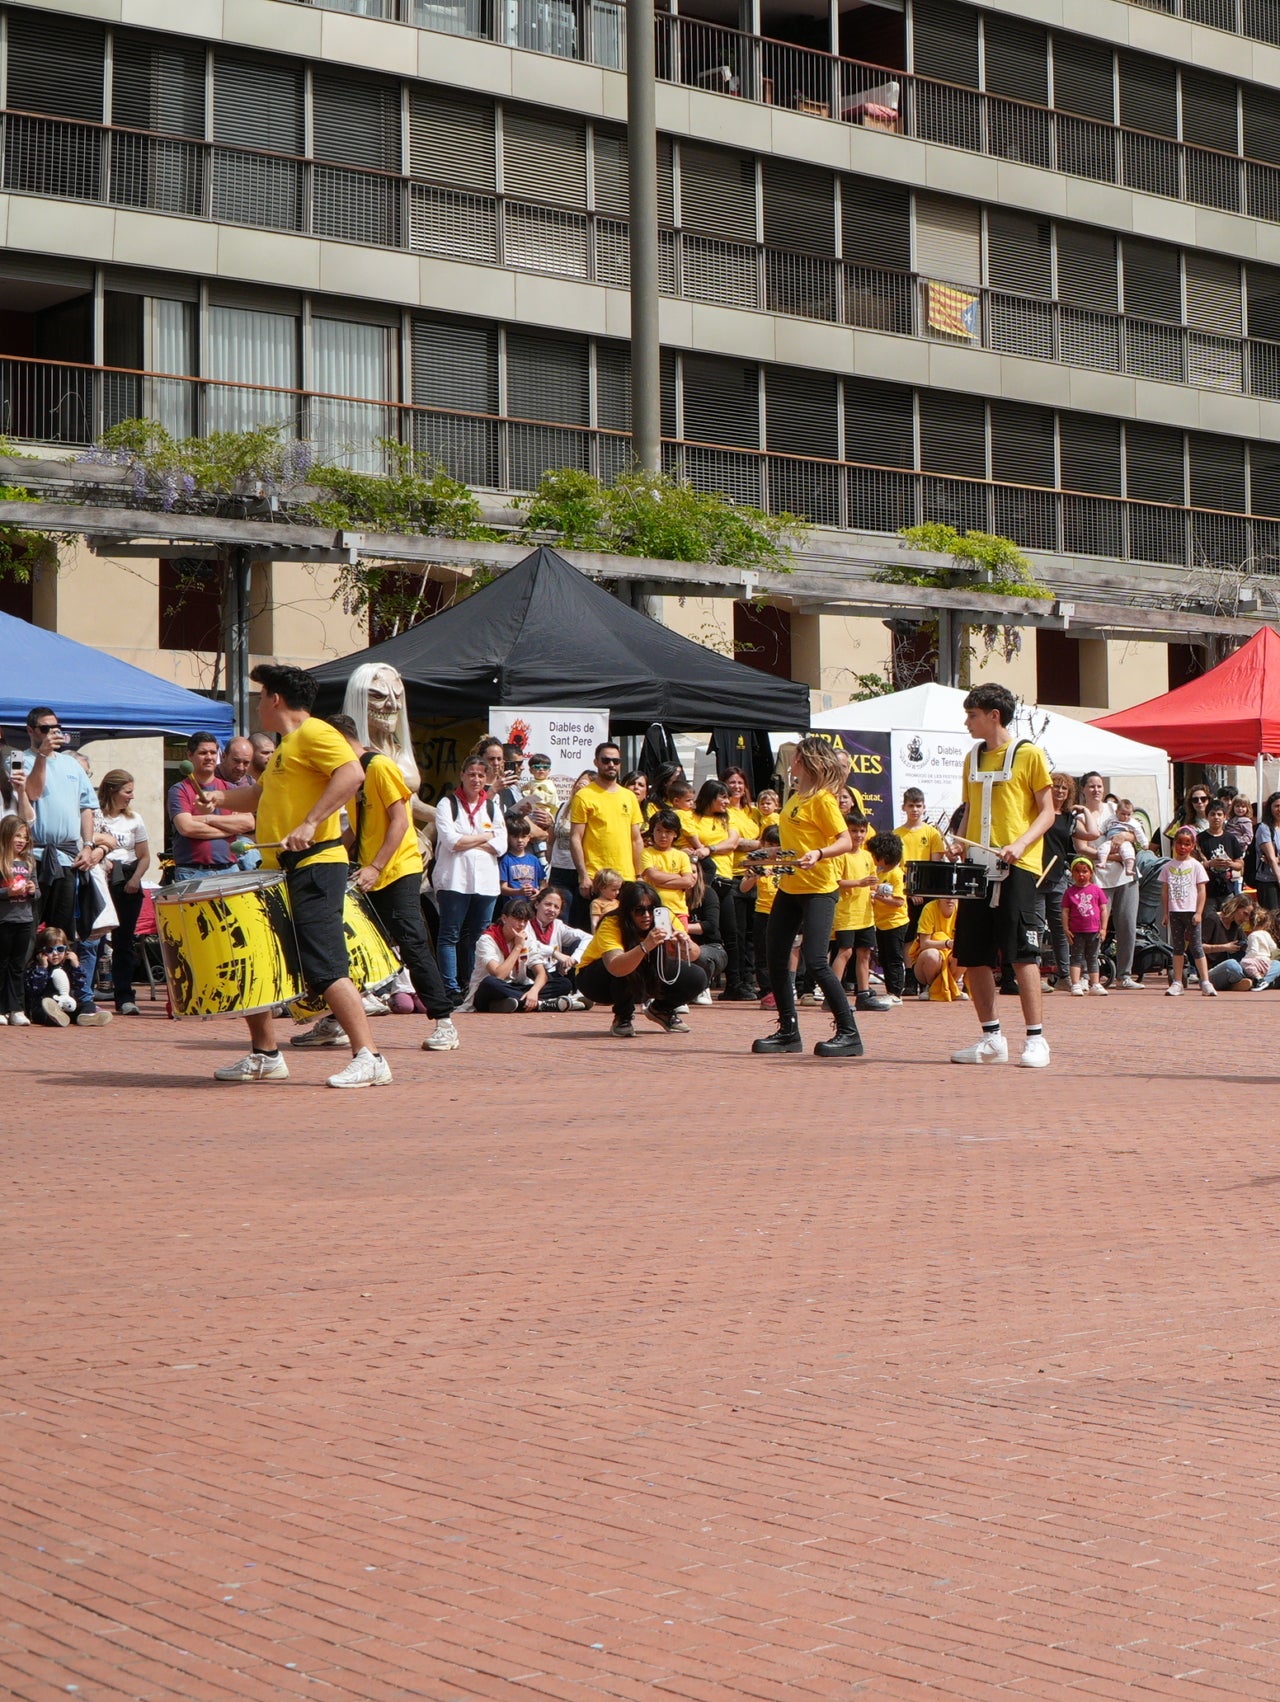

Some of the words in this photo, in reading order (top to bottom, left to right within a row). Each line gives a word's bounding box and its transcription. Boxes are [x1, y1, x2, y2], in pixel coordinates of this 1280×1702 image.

[549, 721, 581, 733] Diables
[583, 723, 595, 733] de
[550, 735, 571, 746] Sant
[572, 736, 593, 747] Pere
[560, 749, 582, 759] Nord
[937, 745, 962, 755] Diables
[848, 754, 883, 774] XES
[930, 758, 939, 767] de
[941, 757, 965, 767] Terrass
